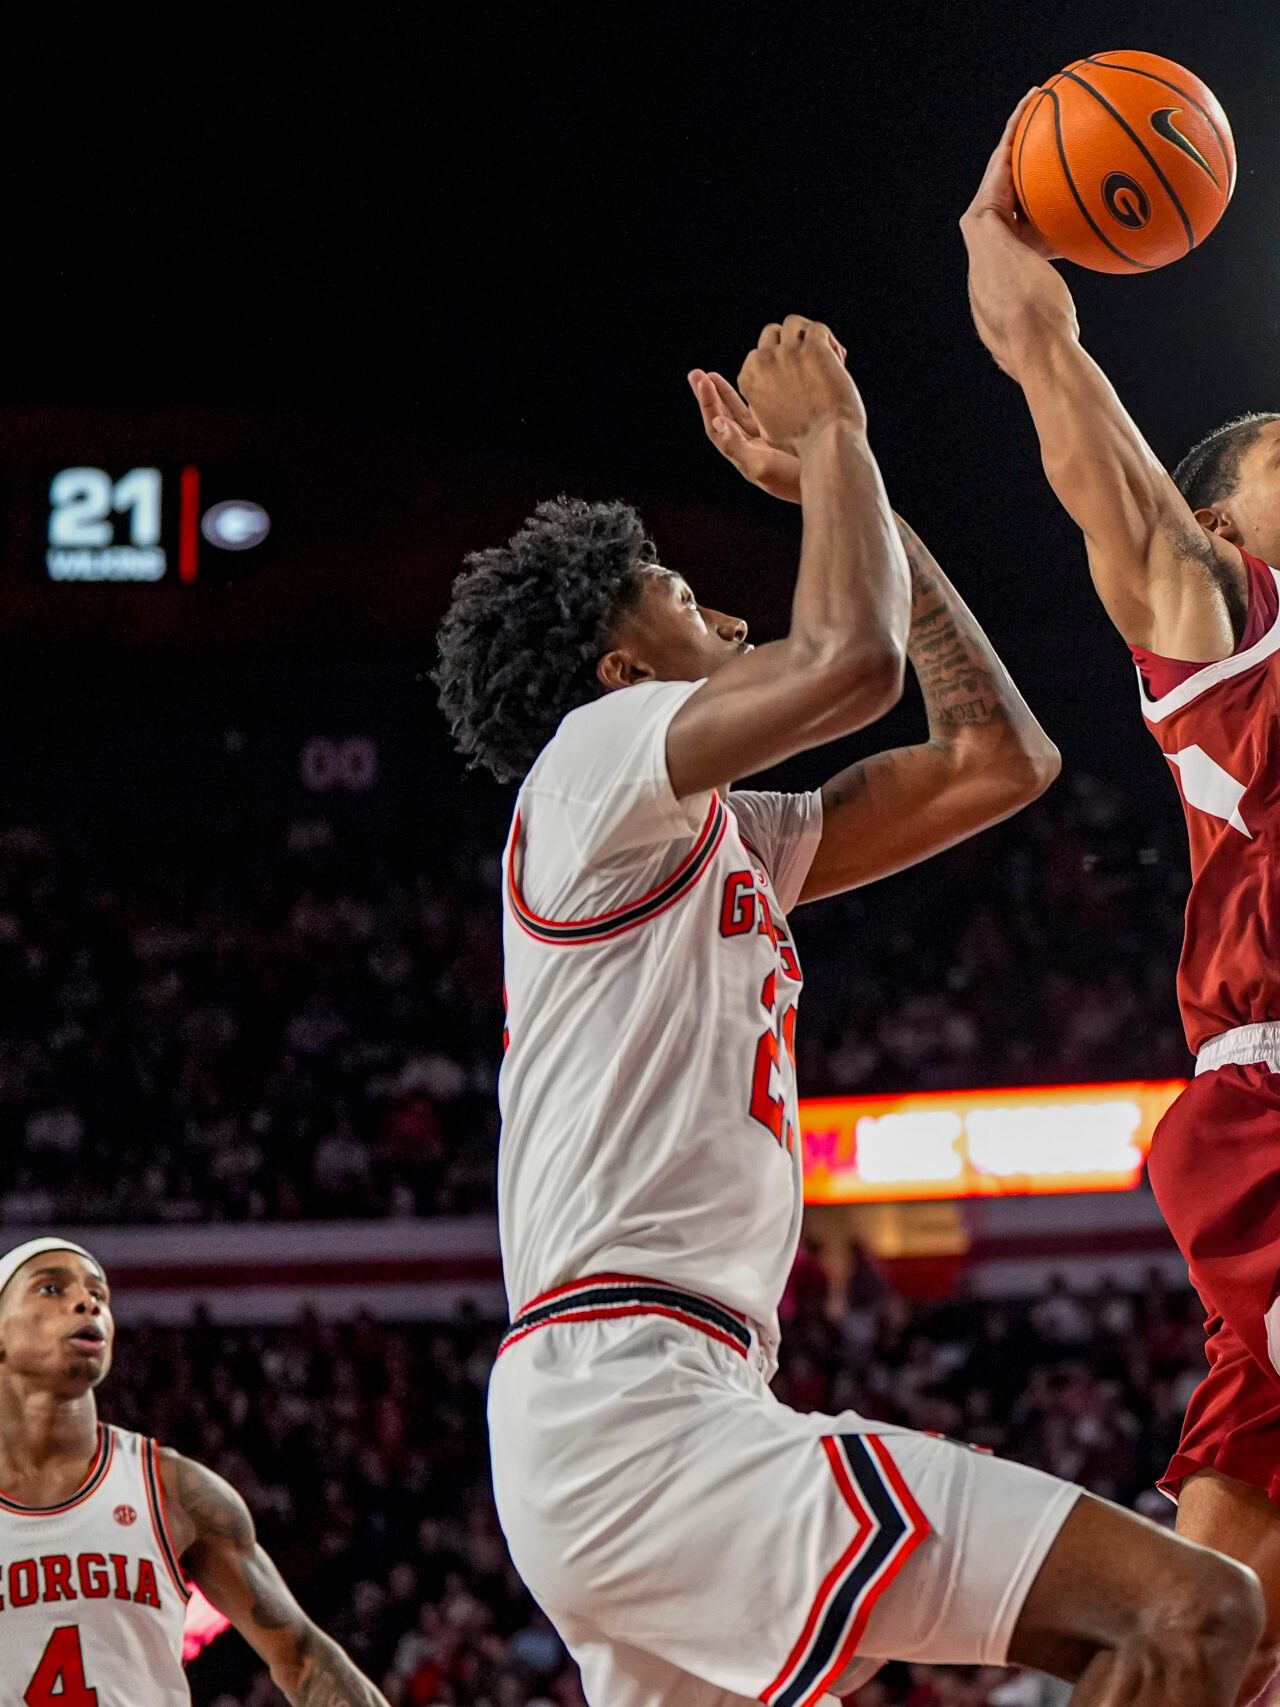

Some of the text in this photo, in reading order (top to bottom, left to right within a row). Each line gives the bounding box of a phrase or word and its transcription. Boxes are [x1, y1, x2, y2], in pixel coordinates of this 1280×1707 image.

[1103, 172, 1151, 229] G
[48, 467, 162, 547] 21
[0, 1554, 161, 1611] ORGIA
[24, 1625, 99, 1707] 4
